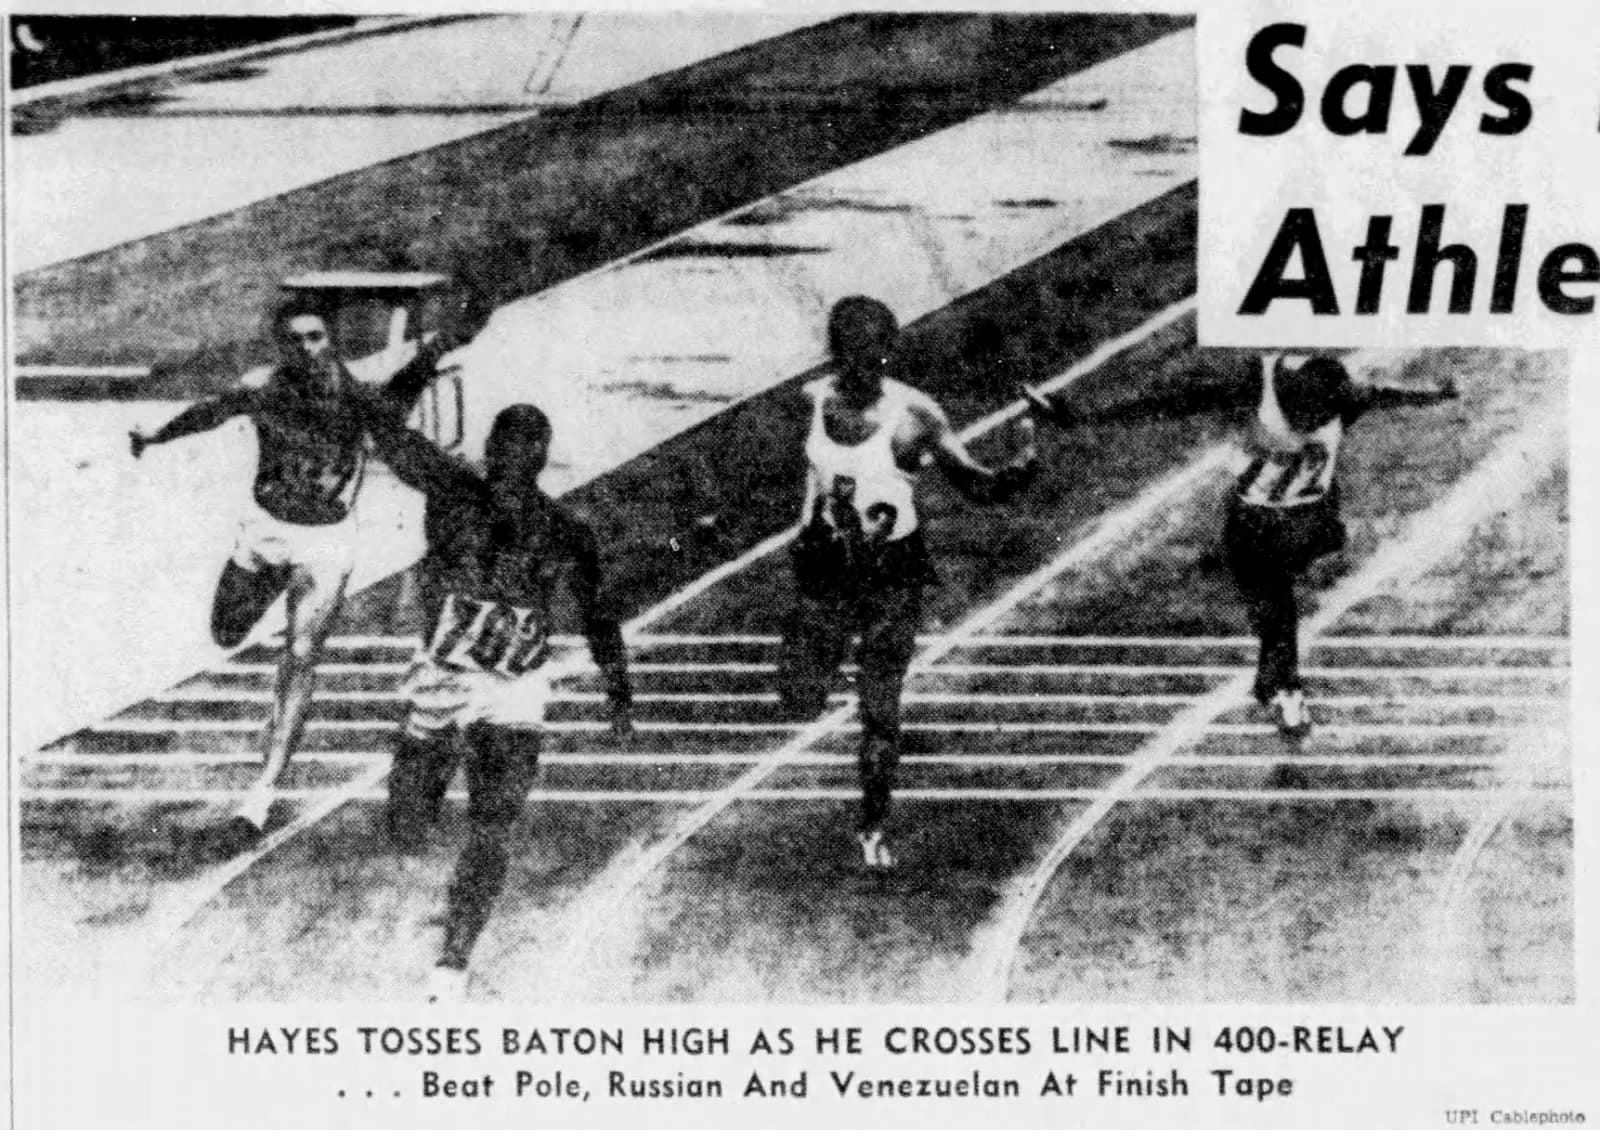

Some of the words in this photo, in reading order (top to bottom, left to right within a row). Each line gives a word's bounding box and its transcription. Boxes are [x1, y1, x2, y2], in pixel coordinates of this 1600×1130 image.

[1237, 22, 1535, 157] Says
[1235, 203, 1600, 316] Athle
[229, 1028, 339, 1055] HAYES
[358, 1027, 482, 1056] TOSSES
[502, 1028, 624, 1056] BATON
[643, 1028, 730, 1056] HIGH
[749, 1028, 796, 1056] AS
[815, 1027, 863, 1055] HE
[884, 1026, 1032, 1056] CROSSES
[1052, 1025, 1130, 1054] LINE
[1152, 1026, 1192, 1054] IN
[1213, 1025, 1405, 1054] 400-RELAY
[422, 1070, 494, 1098] Beat
[516, 1070, 590, 1102] Pole,
[608, 1070, 723, 1099] Russian
[743, 1071, 808, 1099] And
[830, 1070, 1020, 1098] Venezuelan
[1040, 1071, 1077, 1097] At
[1098, 1069, 1189, 1098] Finish
[1211, 1068, 1294, 1101] Tape
[1446, 1109, 1478, 1124] UPI
[1490, 1109, 1586, 1125] Cablephoto
